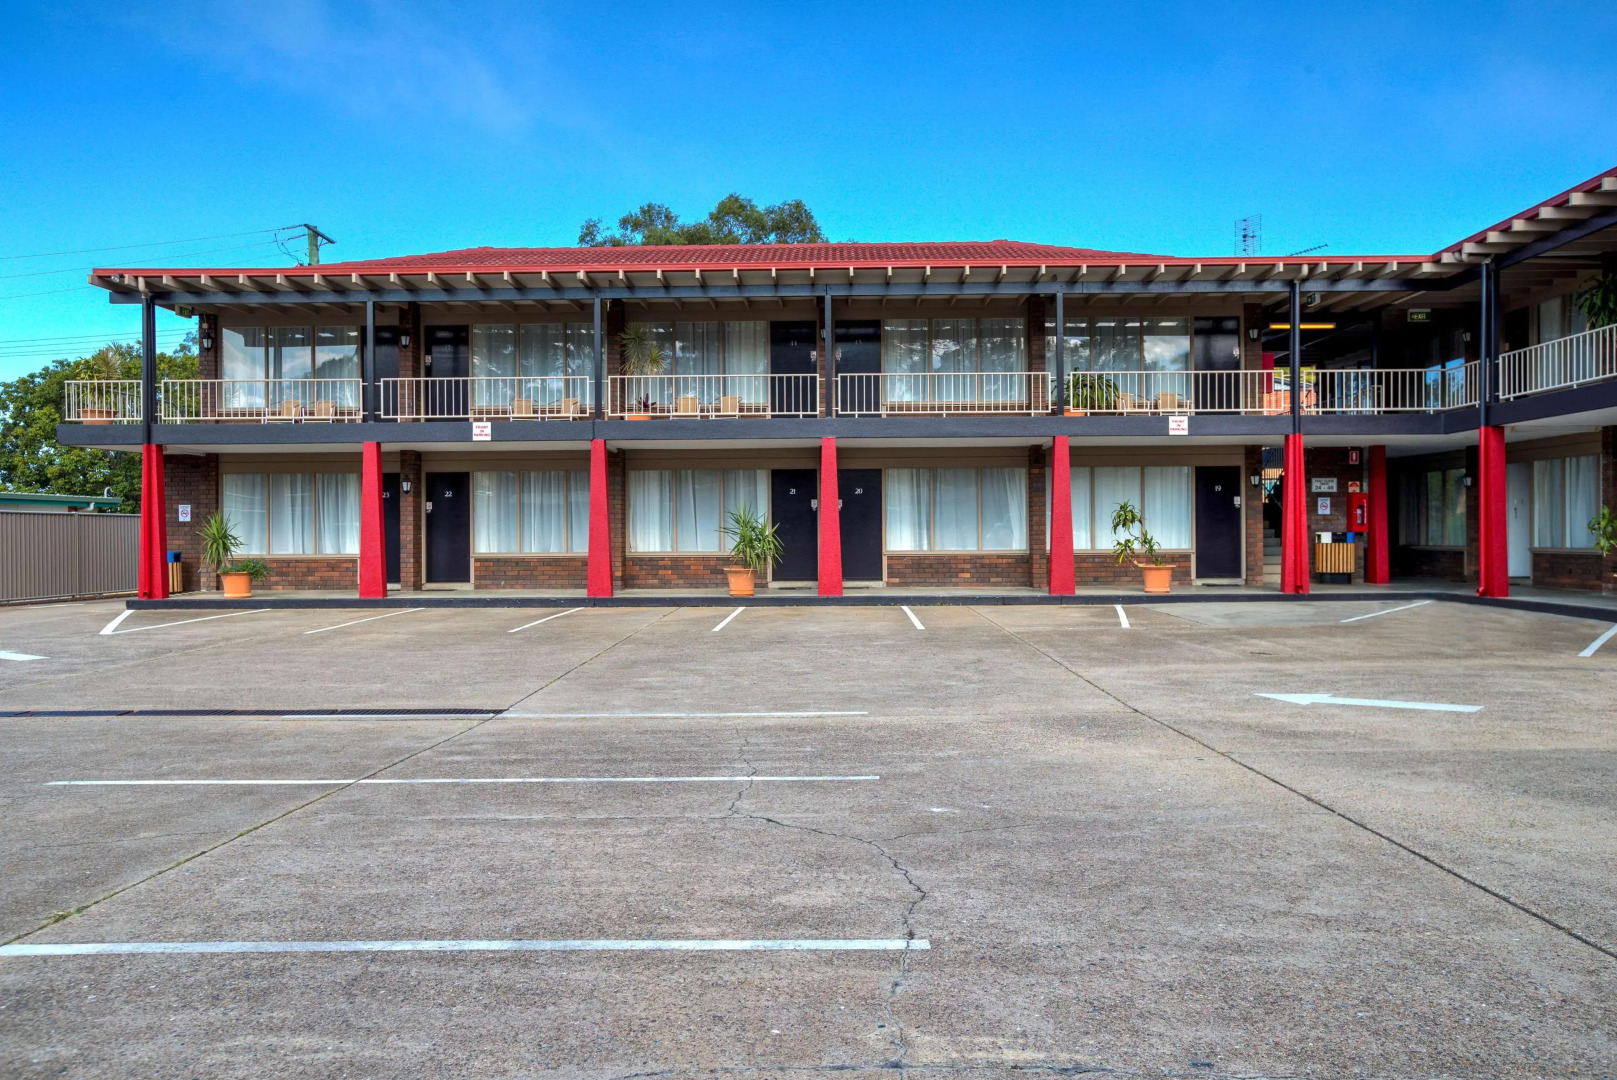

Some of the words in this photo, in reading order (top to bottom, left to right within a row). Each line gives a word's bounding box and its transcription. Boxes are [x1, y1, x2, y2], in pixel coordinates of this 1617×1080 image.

[854, 487, 863, 495] 20
[1214, 484, 1222, 492] 19
[382, 491, 390, 499] 23
[444, 490, 453, 498] 22
